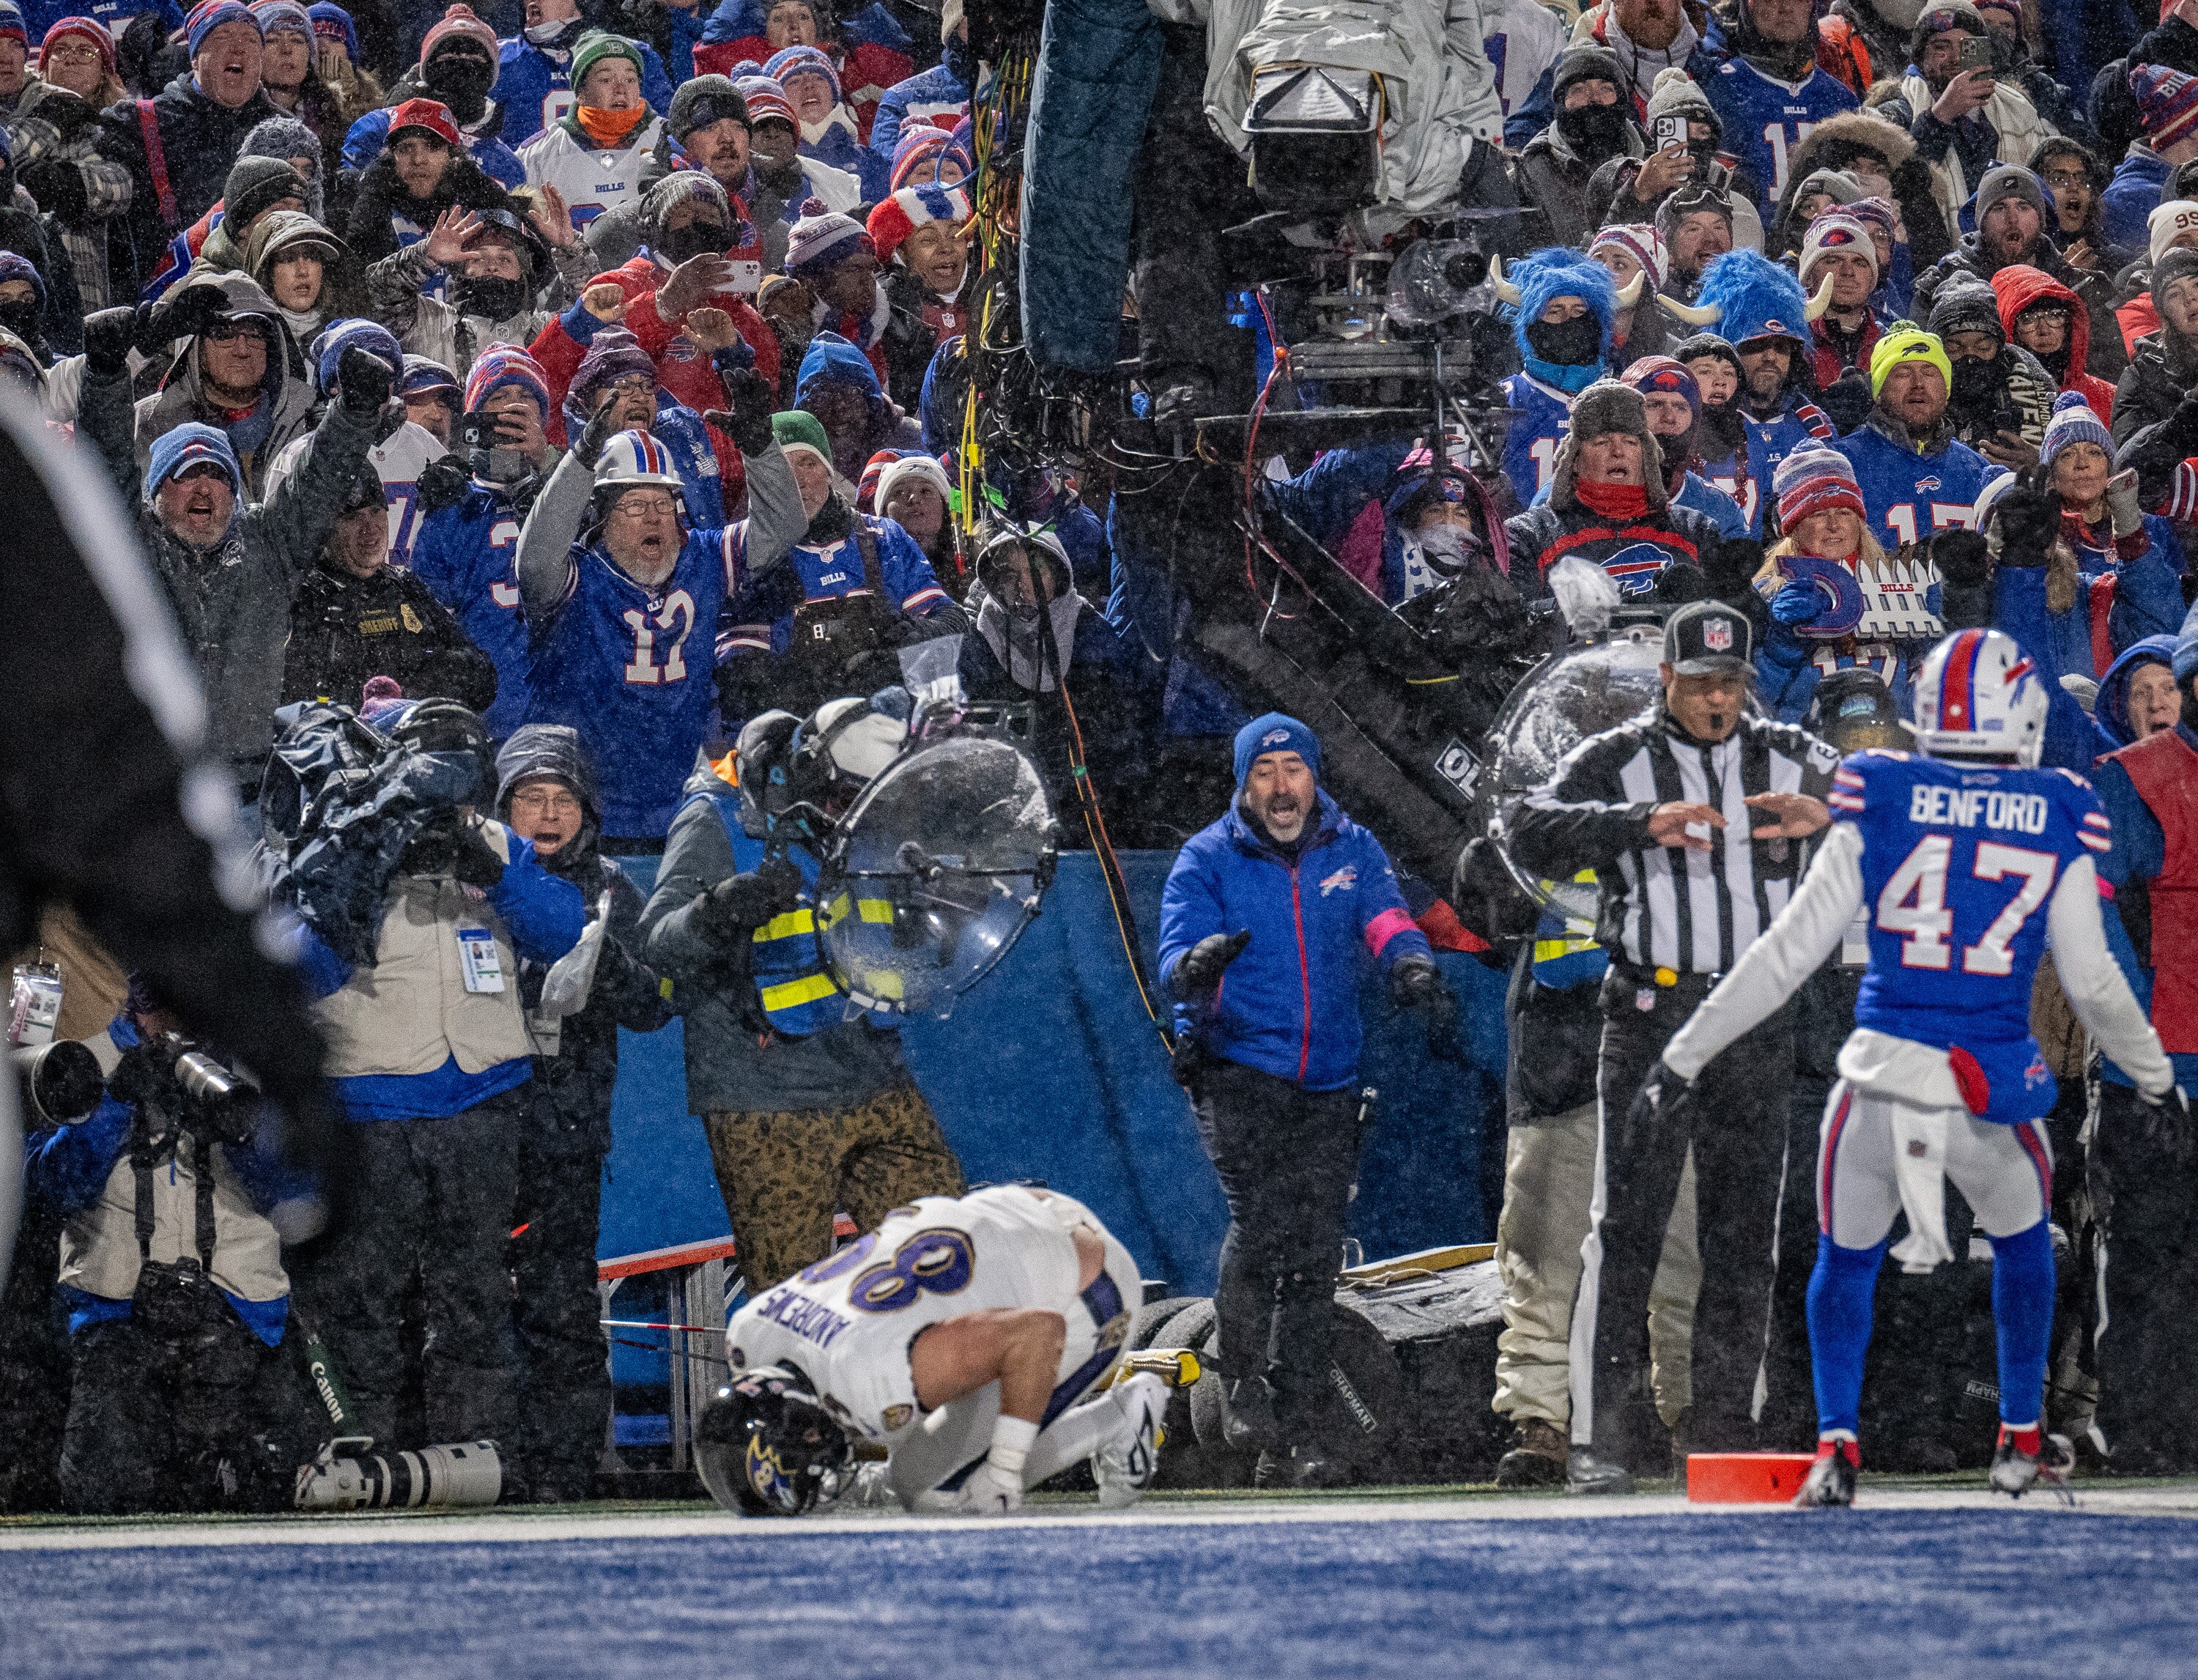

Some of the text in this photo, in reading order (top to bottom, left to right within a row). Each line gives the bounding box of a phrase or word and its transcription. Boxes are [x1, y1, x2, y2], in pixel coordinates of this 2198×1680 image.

[92, 2, 117, 14] BILLS
[1783, 107, 1807, 115] BILLS
[594, 182, 625, 193] BILLS
[820, 571, 846, 586] BILLS
[1879, 583, 1914, 592] BILLS
[359, 617, 398, 634] SHERIFF
[1909, 784, 2049, 835] BENFORD
[1876, 833, 2059, 977] 47
[757, 1287, 851, 1349] ANDREWS
[311, 1361, 344, 1423] Canon
[1330, 1368, 1372, 1426] CHAPMAN
